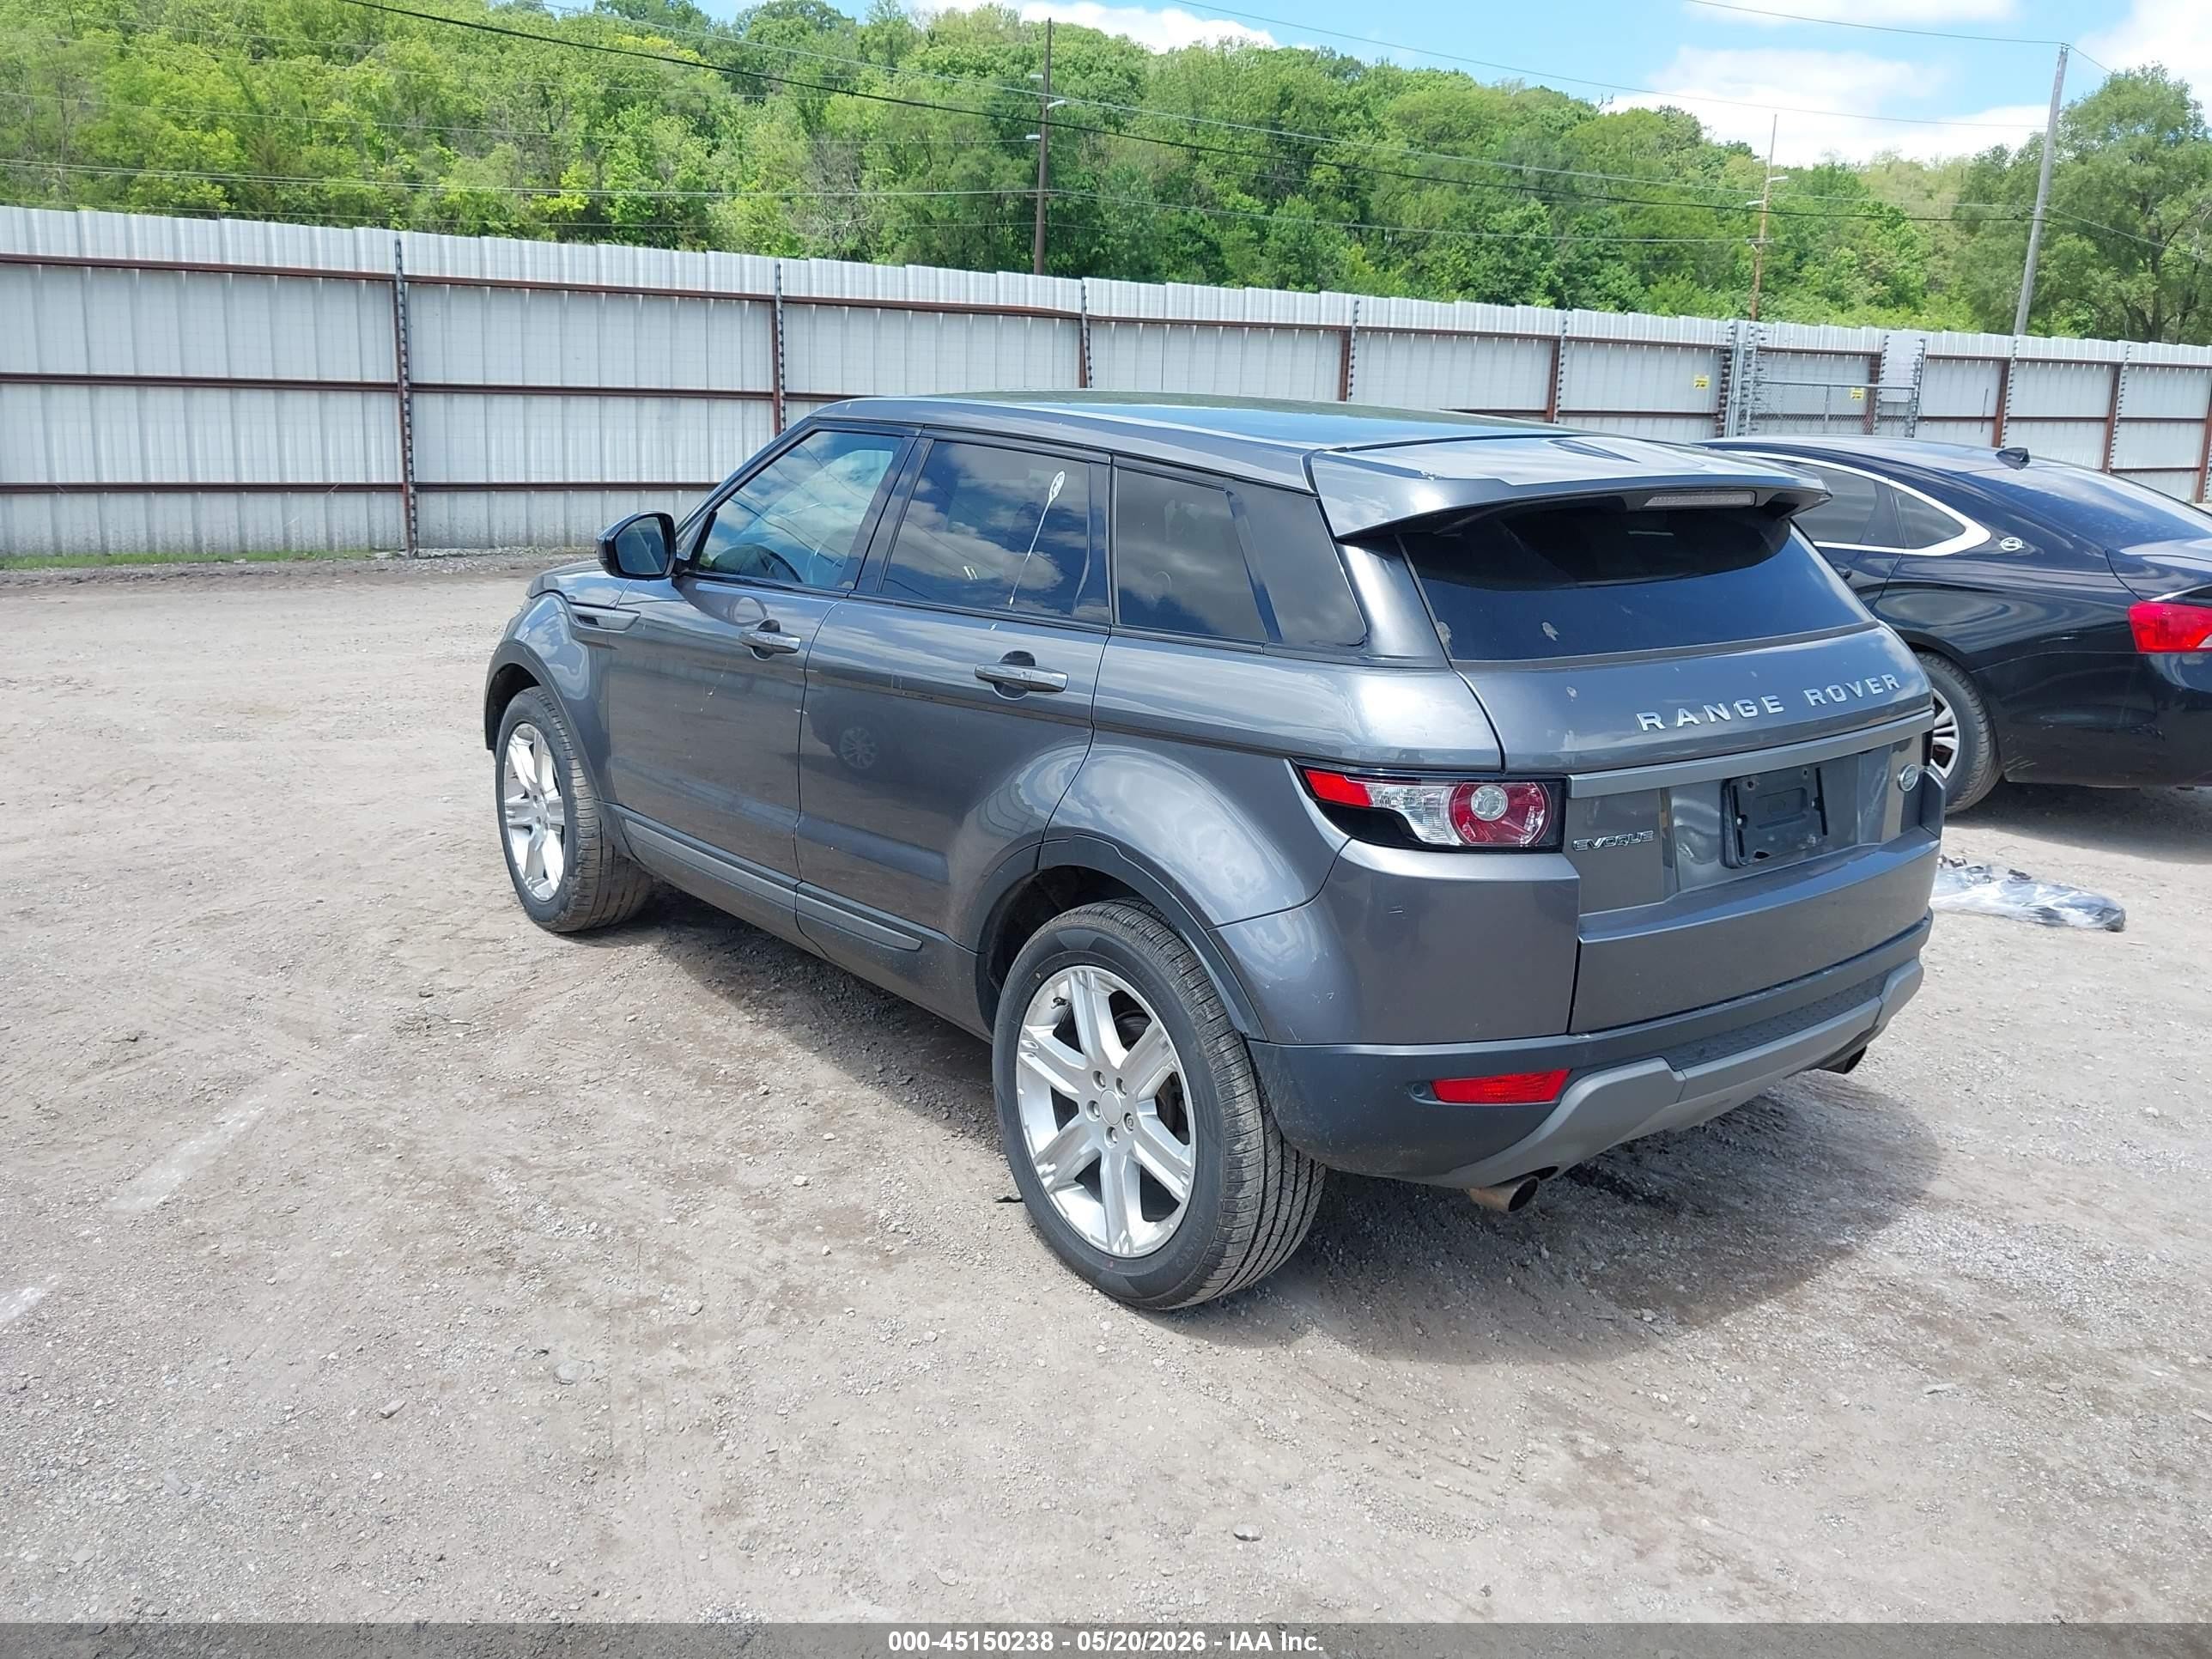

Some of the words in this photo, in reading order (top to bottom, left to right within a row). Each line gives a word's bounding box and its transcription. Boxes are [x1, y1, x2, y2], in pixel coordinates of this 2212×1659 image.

[1635, 694, 1785, 732] RANGE
[1803, 673, 1900, 707] ROVER
[1572, 830, 1654, 851] EVOQUE
